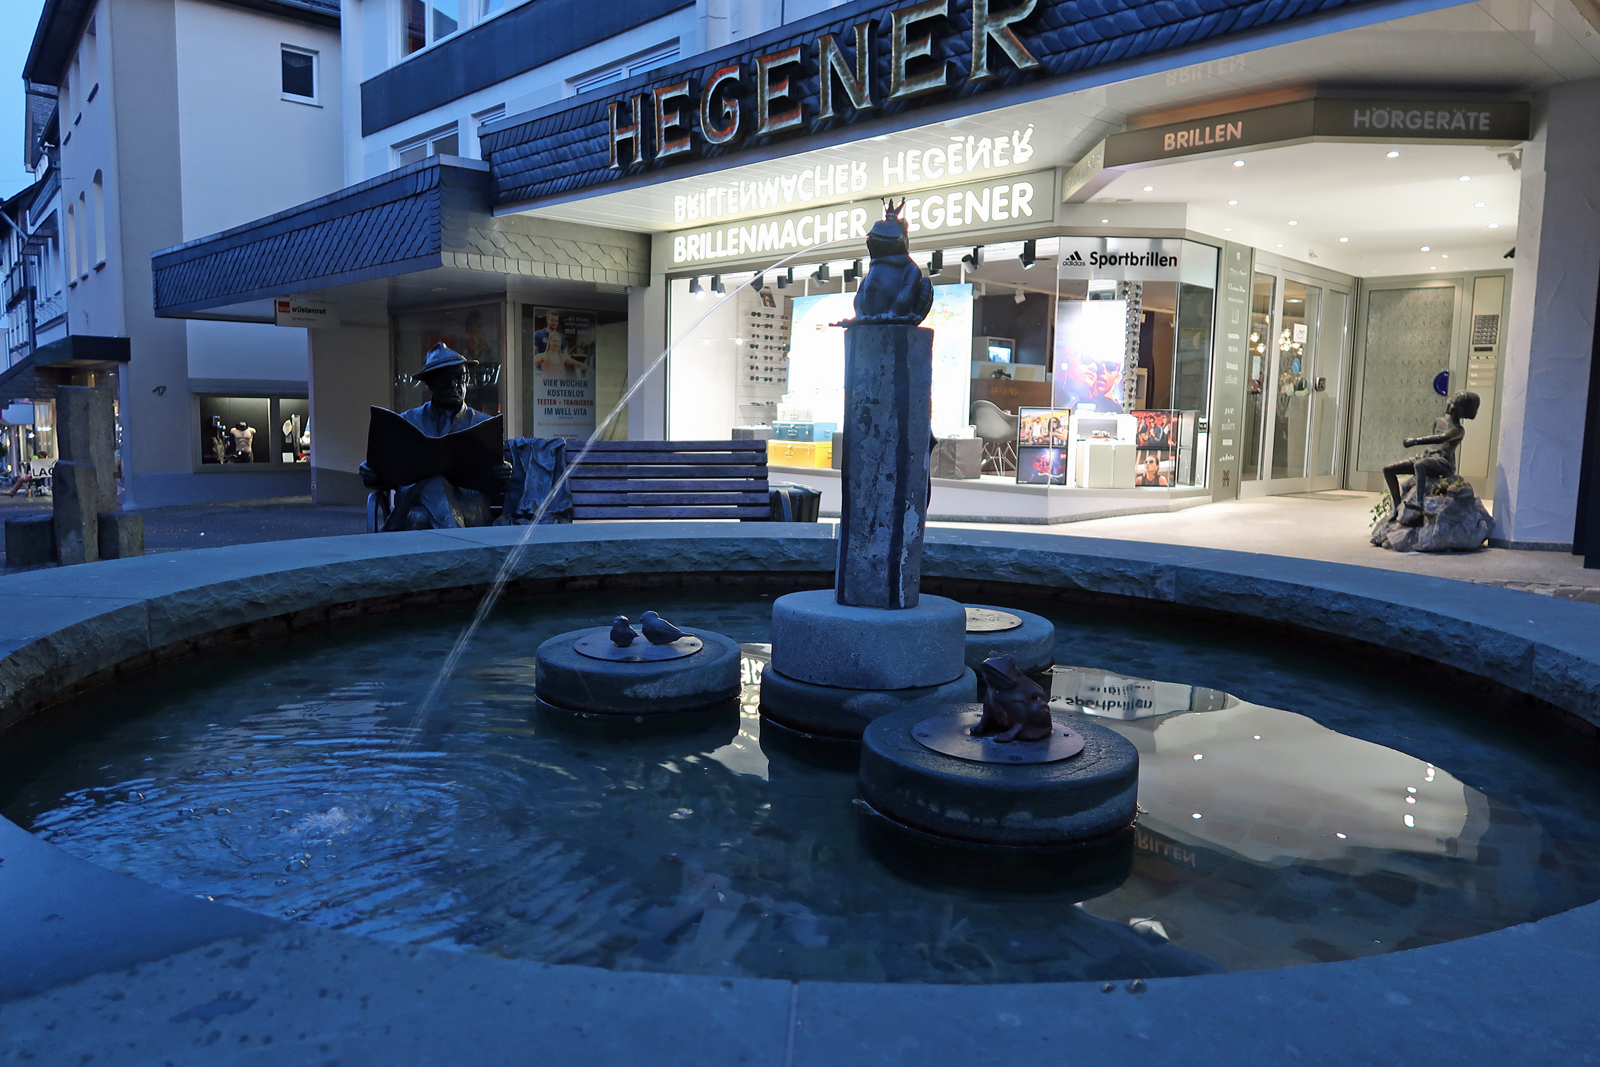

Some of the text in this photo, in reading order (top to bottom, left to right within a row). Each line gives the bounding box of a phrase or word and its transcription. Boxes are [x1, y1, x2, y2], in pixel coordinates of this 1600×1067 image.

[607, 0, 1042, 170] HEGENER
[1353, 107, 1490, 131] HÖRGERÄTE
[1164, 121, 1242, 151] BRILLEN
[673, 207, 868, 263] BRILLENMACHER
[1089, 251, 1177, 269] Sportbrillen
[292, 306, 327, 315] wüstenrot
[543, 379, 588, 388] VIER WOCHEN
[547, 389, 584, 398] KOSTENLOS
[544, 407, 588, 416] IM WELL VITA
